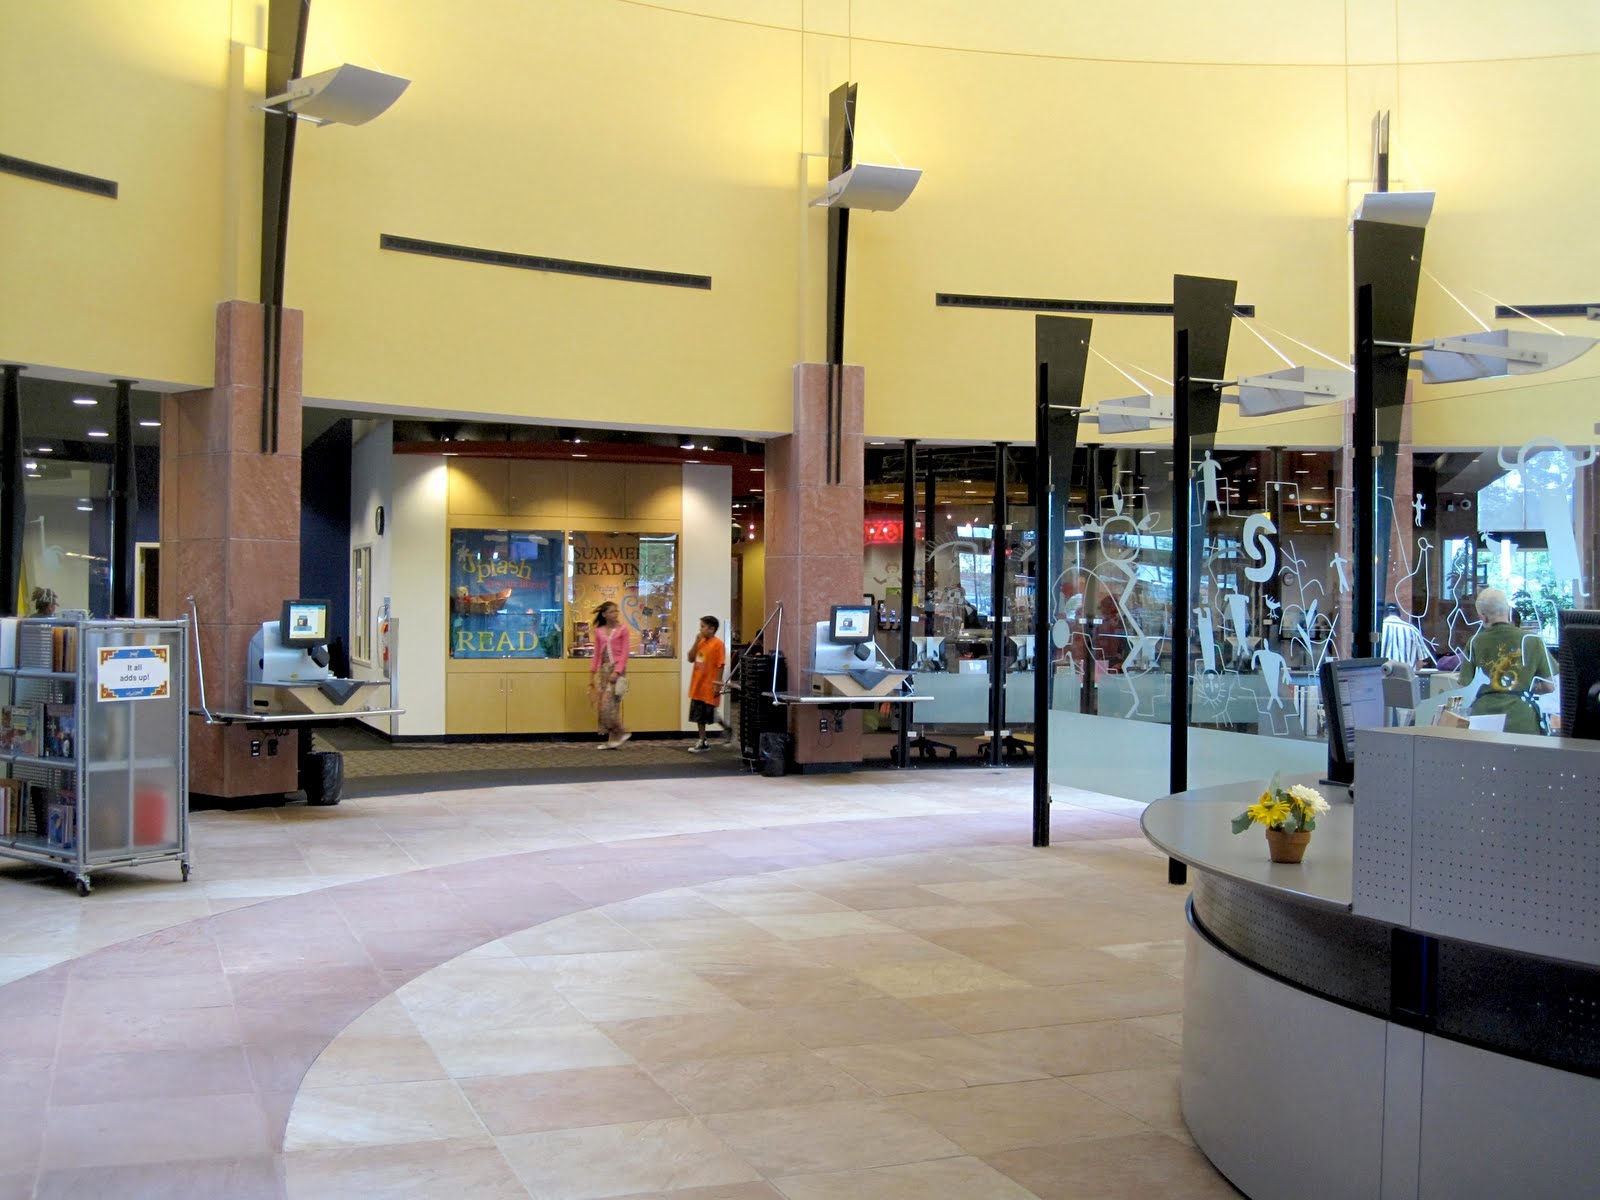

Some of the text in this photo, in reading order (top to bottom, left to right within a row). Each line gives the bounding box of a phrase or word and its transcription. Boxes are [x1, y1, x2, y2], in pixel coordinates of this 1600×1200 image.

[456, 630, 540, 652] READ
[120, 673, 150, 682] adds up!
